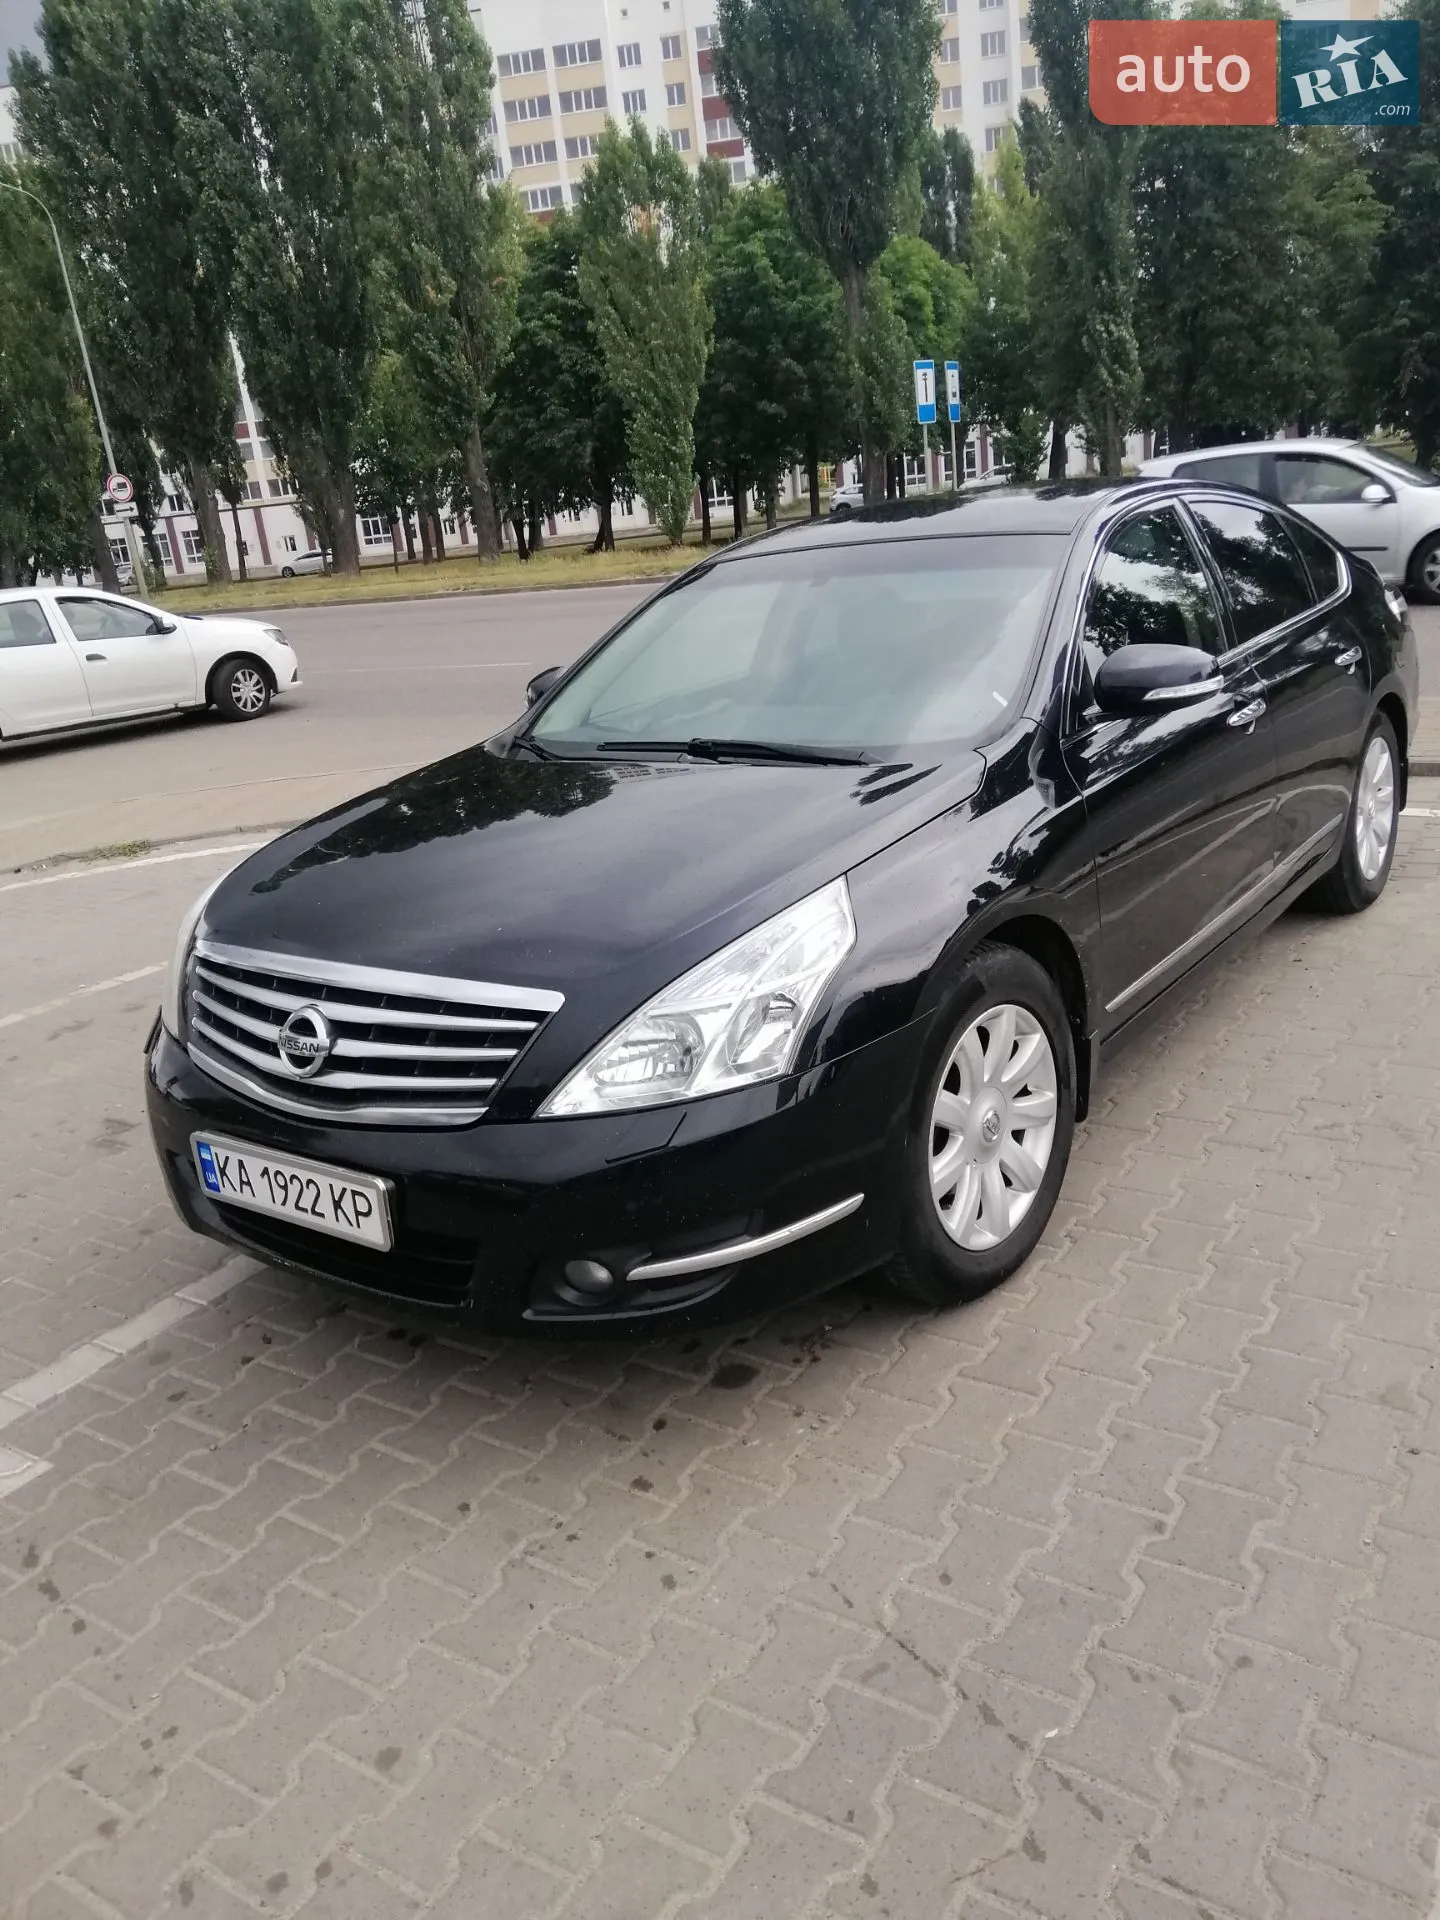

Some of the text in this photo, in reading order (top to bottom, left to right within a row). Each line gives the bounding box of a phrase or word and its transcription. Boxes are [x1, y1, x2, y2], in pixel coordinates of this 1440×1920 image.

[280, 1038, 319, 1053] NISSAN
[205, 1171, 218, 1185] UA
[214, 1152, 373, 1229] KA 1922 KP
